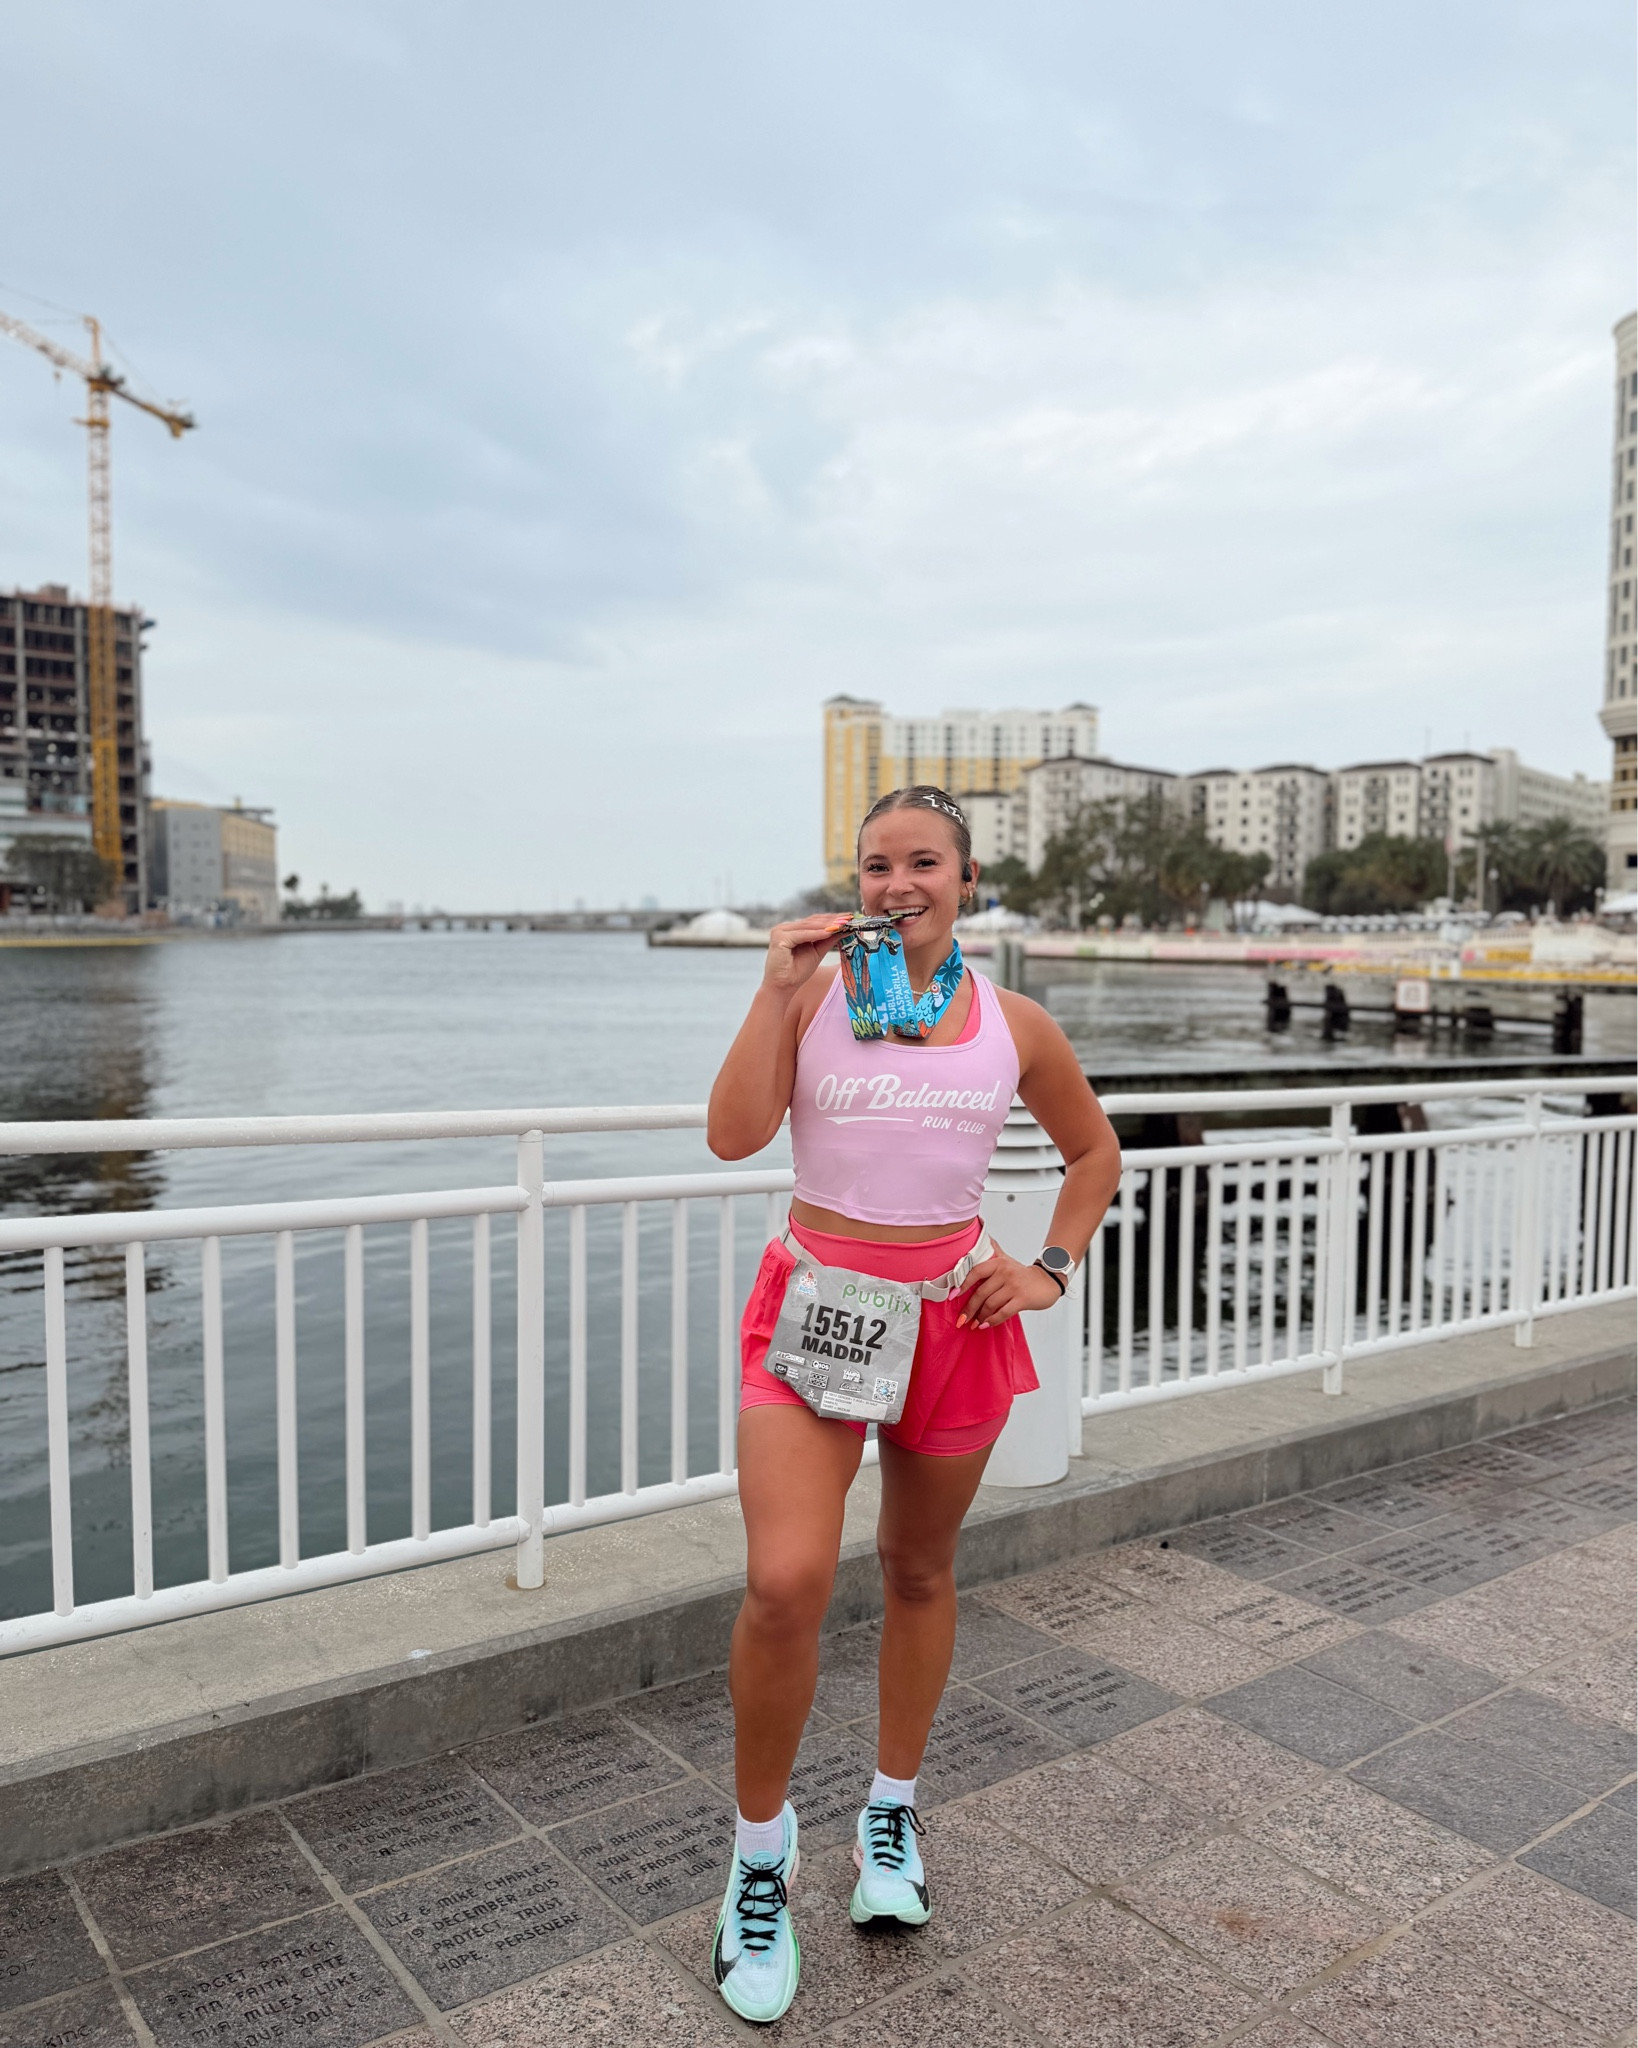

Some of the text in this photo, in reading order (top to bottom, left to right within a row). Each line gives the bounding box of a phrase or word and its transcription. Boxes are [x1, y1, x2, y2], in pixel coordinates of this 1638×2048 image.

[885, 988, 897, 1020] PUBLIX
[891, 965, 906, 1019] GASPARILLA
[900, 970, 914, 1017] TAMPA 2026
[815, 1074, 1001, 1112] Off Balanced
[922, 1116, 986, 1135] RUN CLUB
[800, 1302, 887, 1350] 15512
[801, 1335, 872, 1366] MADDI
[961, 1704, 988, 1714] IZZY
[1018, 1697, 1045, 1709] LOVE
[1042, 1700, 1078, 1716] TAMPA
[1091, 1700, 1118, 1712] 2015
[931, 1712, 1008, 1741] THAT CHANGED
[943, 1743, 969, 1754] LIFE
[969, 1726, 1017, 1744] FOREVER
[812, 1765, 867, 1786] WAMBLE
[822, 1755, 846, 1765] MR
[531, 1760, 652, 1804] EVERLASTING LOVE
[579, 1843, 605, 1855] MY
[609, 1816, 683, 1844] BEAUTIFUL
[653, 1823, 713, 1848] ALWAYS
[713, 1815, 735, 1825] BE
[606, 1836, 730, 1885] THE FROSTING ON
[386, 1911, 413, 1927] LIZ
[437, 1887, 479, 1908] MIKE
[483, 1861, 553, 1891] CHARLES
[432, 1893, 519, 1931] DECEMBER
[523, 1877, 561, 1896] 2015
[514, 1896, 563, 1921] TRUST
[495, 1910, 584, 1950] PERSEVERE
[165, 1939, 336, 2005] BRIDGET PATRICK
[178, 1953, 346, 2023] FINN FAITH CATE
[192, 1972, 363, 2043] MIA MILES LUKE
[293, 2006, 333, 2028] YOU
